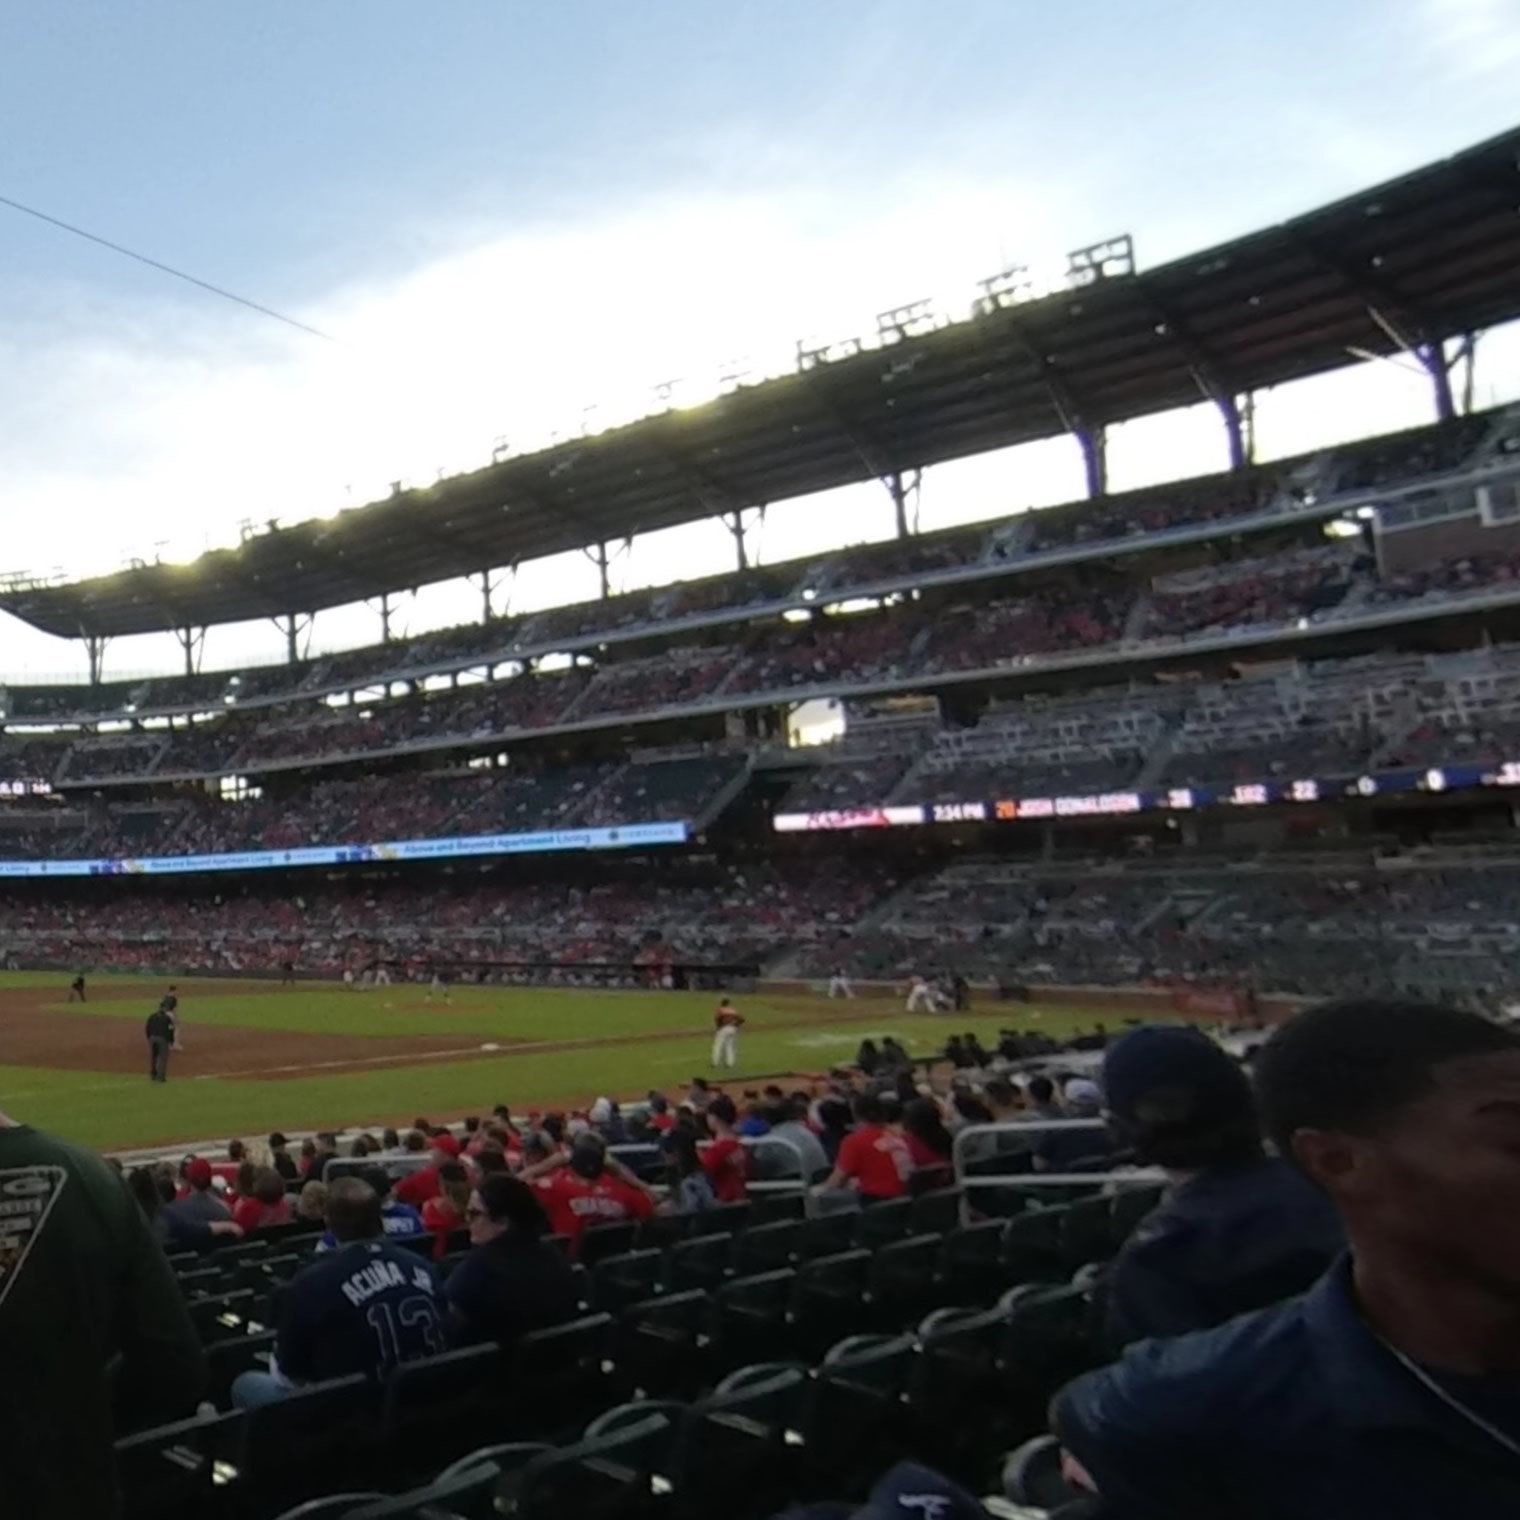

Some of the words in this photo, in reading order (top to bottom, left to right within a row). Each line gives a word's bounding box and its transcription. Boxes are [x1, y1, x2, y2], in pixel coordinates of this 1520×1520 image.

[1017, 799, 1053, 817] JOSH
[1055, 794, 1140, 815] DONALDSON
[404, 842, 434, 855] Above
[497, 835, 555, 849] Apartment
[557, 831, 591, 846] Living
[340, 1259, 407, 1308] ACUÑA
